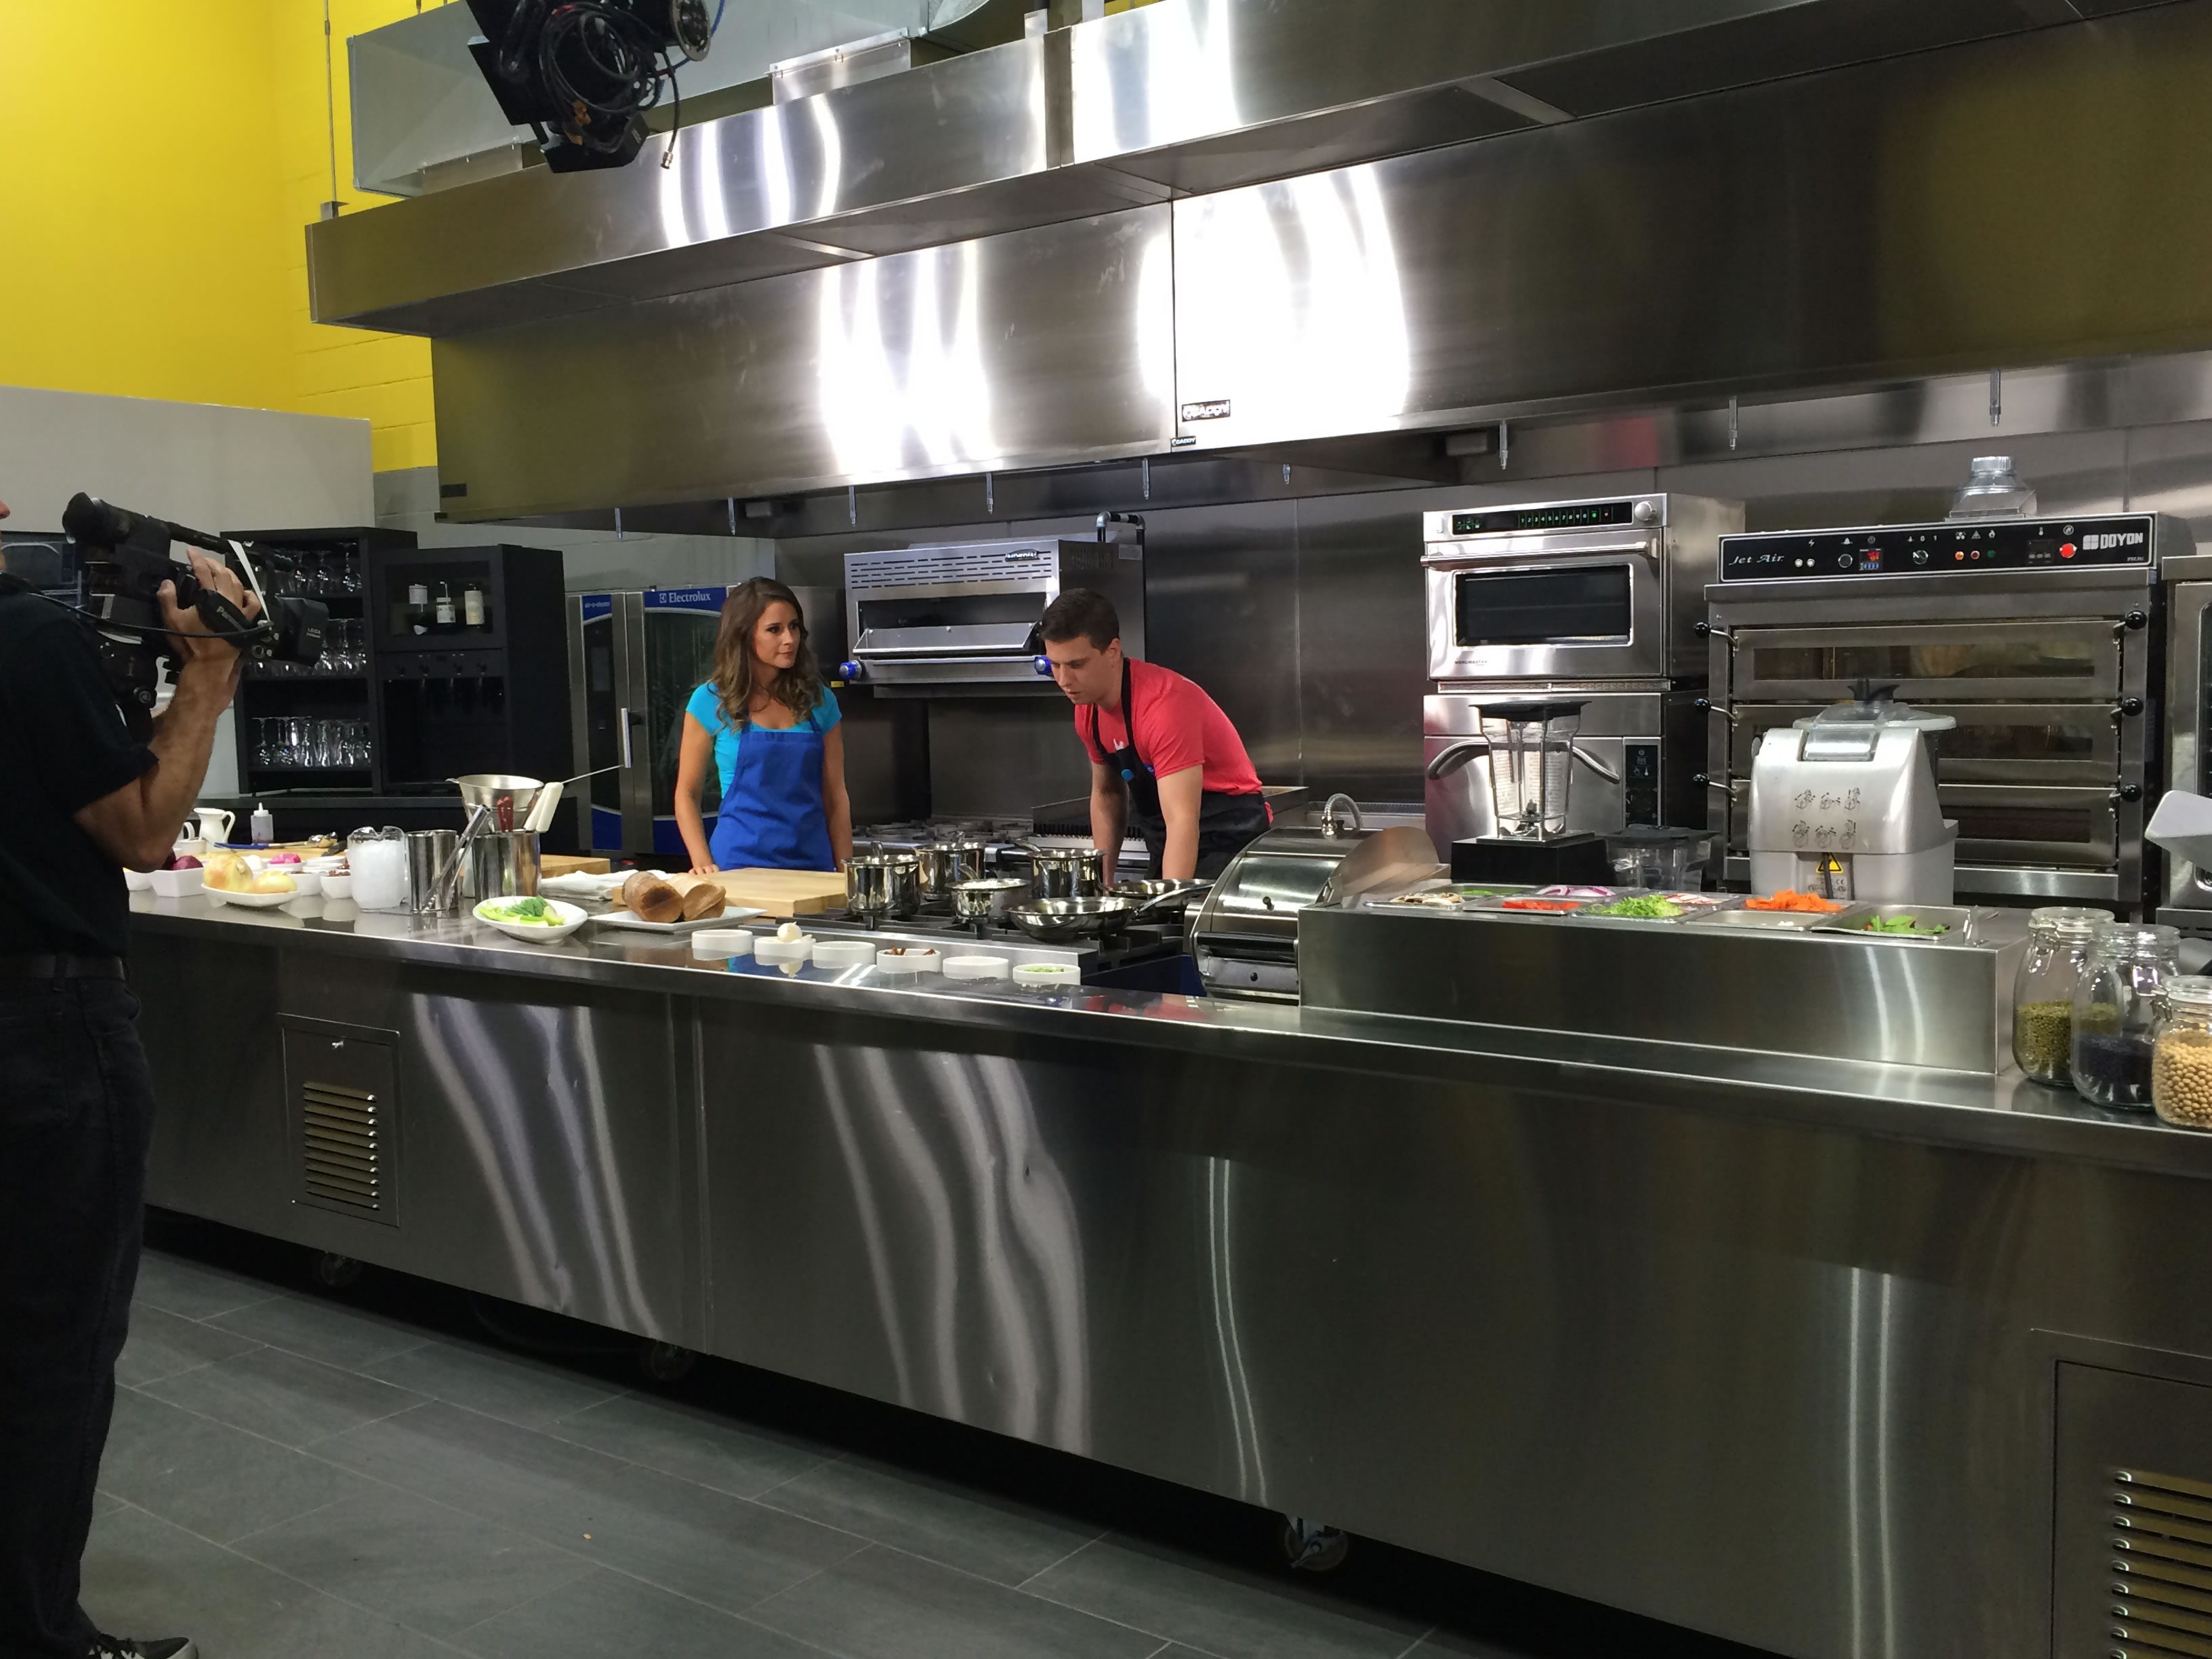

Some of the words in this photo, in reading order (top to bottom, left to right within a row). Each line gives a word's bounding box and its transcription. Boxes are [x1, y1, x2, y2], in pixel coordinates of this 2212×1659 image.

[2100, 532, 2144, 549] DOYON
[1728, 556, 1753, 566] Jet
[668, 592, 712, 603] Electrolux
